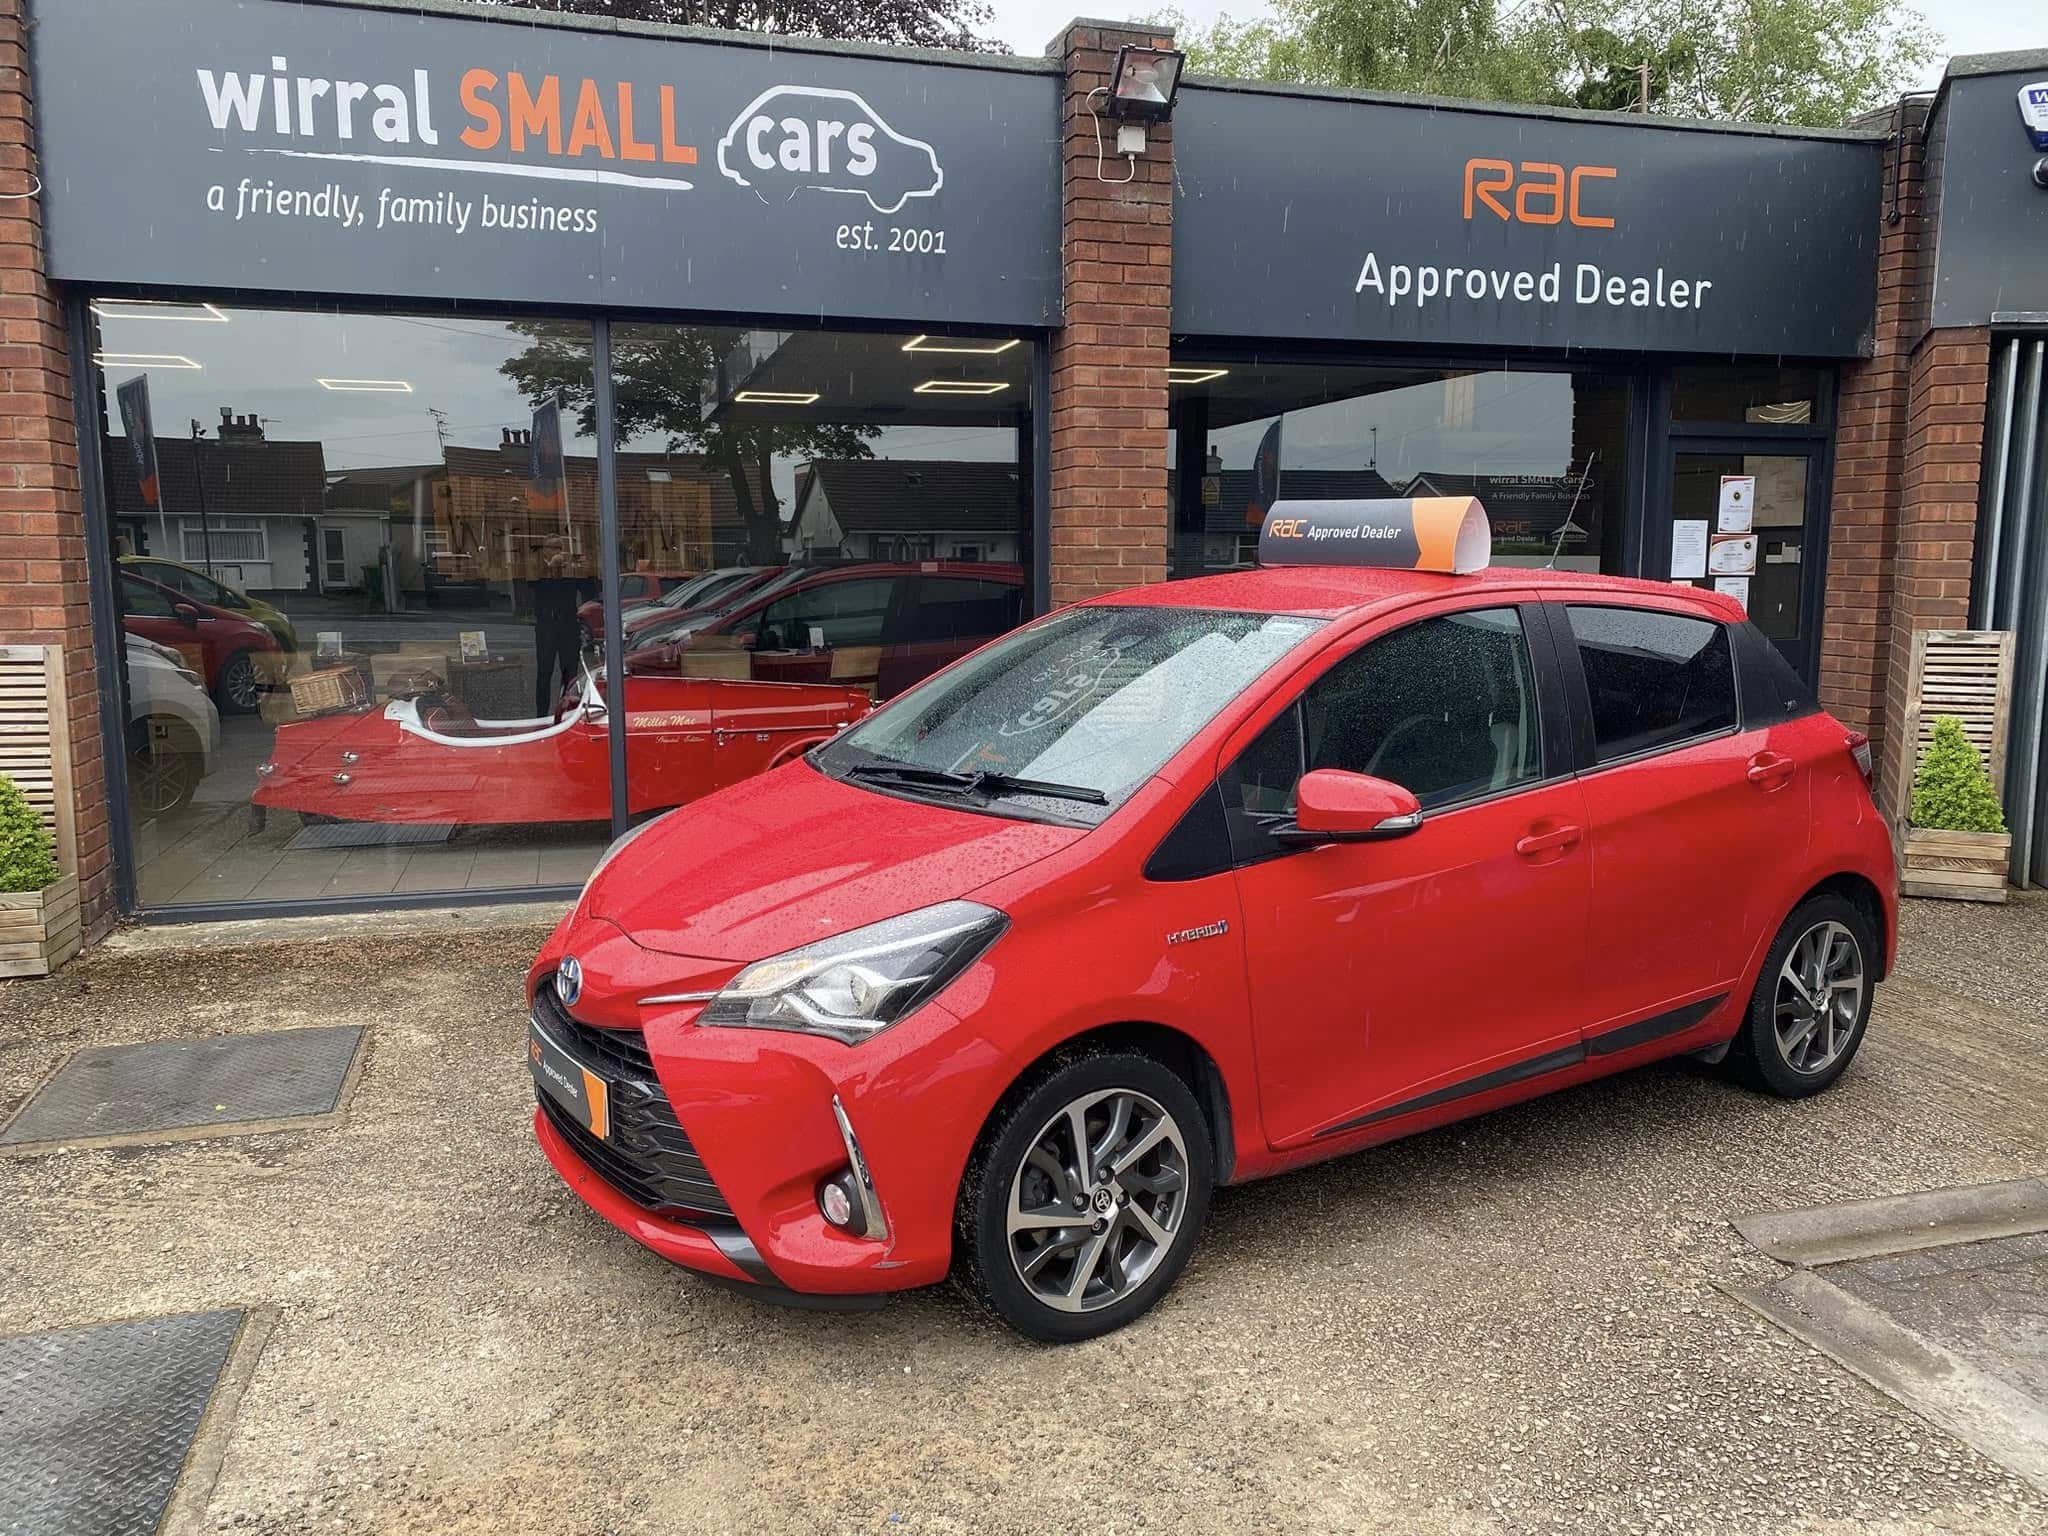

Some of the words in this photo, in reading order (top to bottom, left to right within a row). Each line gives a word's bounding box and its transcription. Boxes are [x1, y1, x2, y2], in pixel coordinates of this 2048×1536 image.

[196, 56, 438, 146] wirral
[460, 68, 698, 165] SMALL
[746, 116, 878, 175] cars
[206, 185, 225, 212] a
[235, 179, 366, 231] friendly,
[376, 187, 473, 231] family
[481, 197, 598, 233] business
[836, 222, 879, 251] est.
[888, 228, 947, 255] 2001
[1355, 252, 1561, 308] Approved
[1576, 264, 1713, 309] Dealer
[1521, 475, 1555, 484] SMALL
[1307, 526, 1359, 541] Approved
[1361, 525, 1402, 540] Dealer
[1167, 924, 1219, 944] HYBRID
